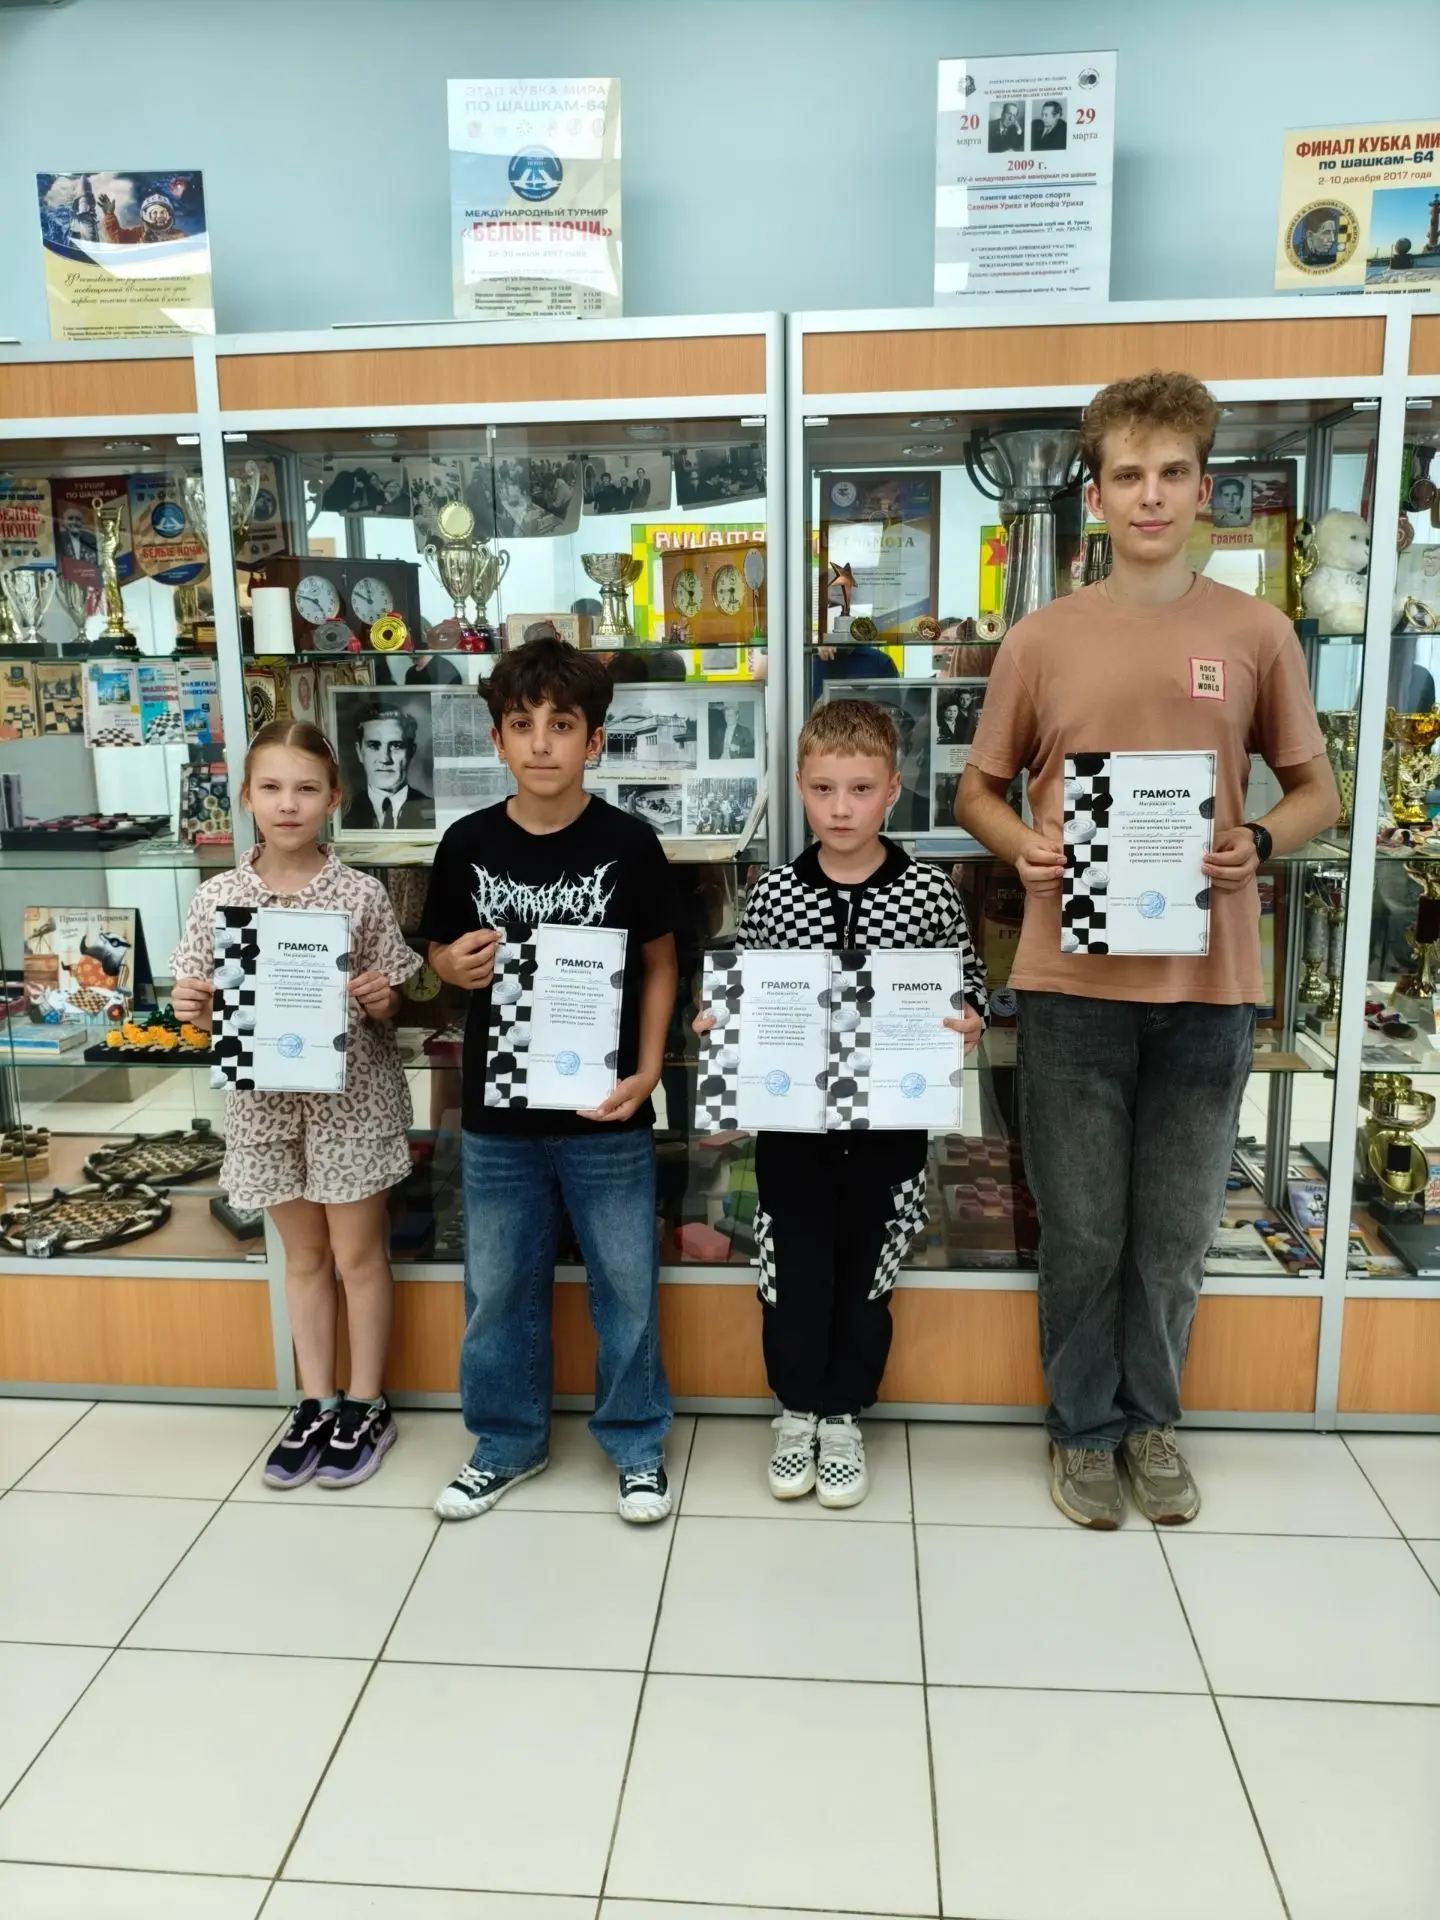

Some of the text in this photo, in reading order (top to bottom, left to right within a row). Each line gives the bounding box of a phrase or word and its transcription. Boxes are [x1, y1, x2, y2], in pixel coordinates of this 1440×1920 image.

[466, 85, 606, 96] ЭТАП КУБКА МИРА
[465, 100, 607, 113] ПО ШАШКАМ-64
[1075, 108, 1096, 125] 29
[960, 114, 980, 130] 20
[956, 138, 982, 146] марта
[1072, 132, 1098, 142] марта
[1296, 132, 1440, 158] ФИНАЛ КУБКА МИ
[1007, 160, 1047, 171] 2009 г.
[1318, 160, 1337, 170] по
[1342, 174, 1381, 184] декабря
[1383, 171, 1408, 181] 2017
[1410, 171, 1432, 180] года
[980, 192, 1071, 202] памяти мастеров спорта
[465, 208, 608, 218] МЕЖДУНАРОДНЫЙ ТУРНИР
[549, 221, 613, 242] НОЧИ»
[1210, 533, 1254, 545] Грамота
[1199, 664, 1217, 673] ROCK
[1201, 673, 1216, 682] THIS
[1198, 682, 1220, 692] WORLD
[1133, 789, 1191, 799] ГРАМОТА
[278, 942, 329, 952] ГРАМОТА
[555, 958, 604, 969] ГРАМОТА
[761, 981, 810, 989] ГРАМОТА
[892, 983, 942, 991] ГРАМОТА
